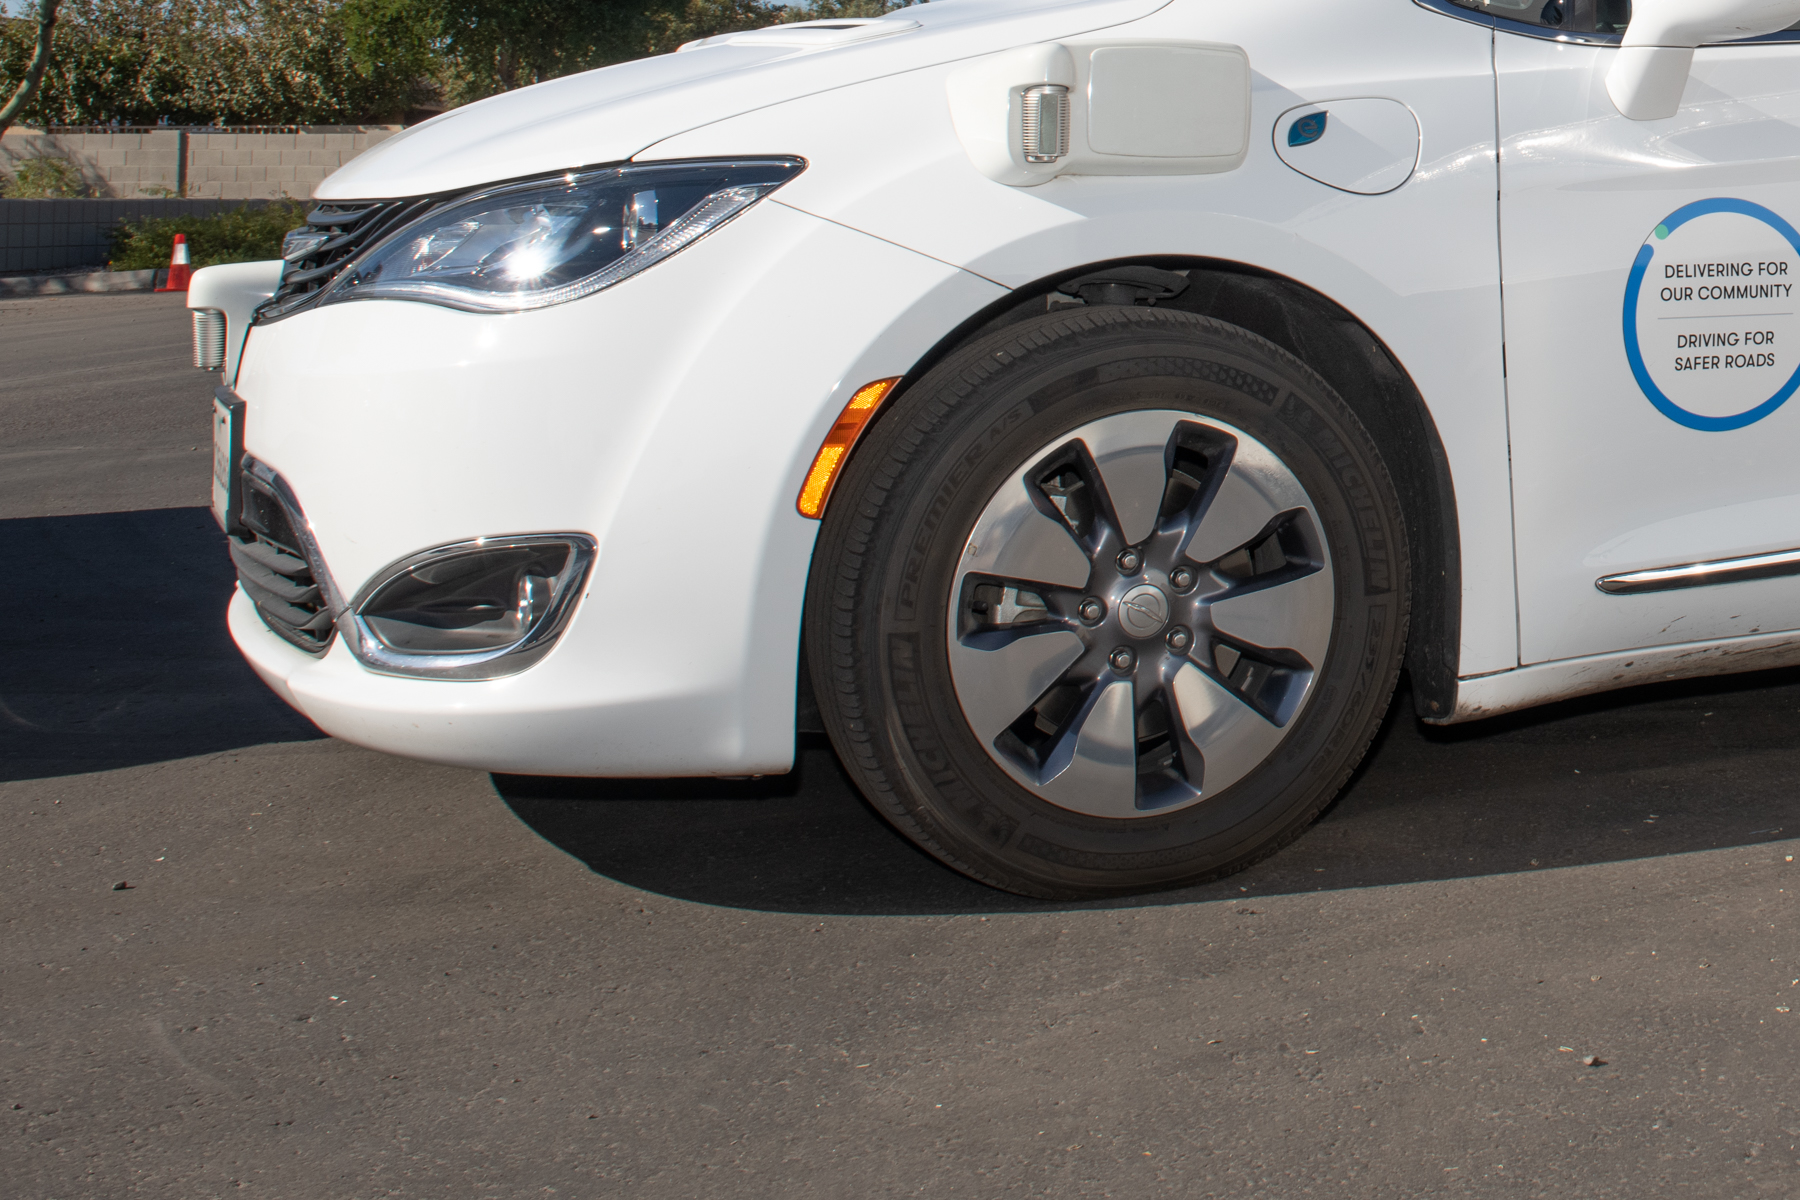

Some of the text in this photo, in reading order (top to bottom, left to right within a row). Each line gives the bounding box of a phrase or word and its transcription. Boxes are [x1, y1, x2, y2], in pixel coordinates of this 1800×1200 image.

[1664, 261, 1788, 279] DELIVERING FOR
[1660, 284, 1793, 301] OUR COMMUNITY
[1677, 331, 1774, 348] DRIVING FOR
[1674, 353, 1775, 371] SAFER ROADS
[901, 408, 1023, 609] PREMIER A/S
[1317, 428, 1389, 587] MICHELIN
[891, 636, 978, 818] MICHELIN
